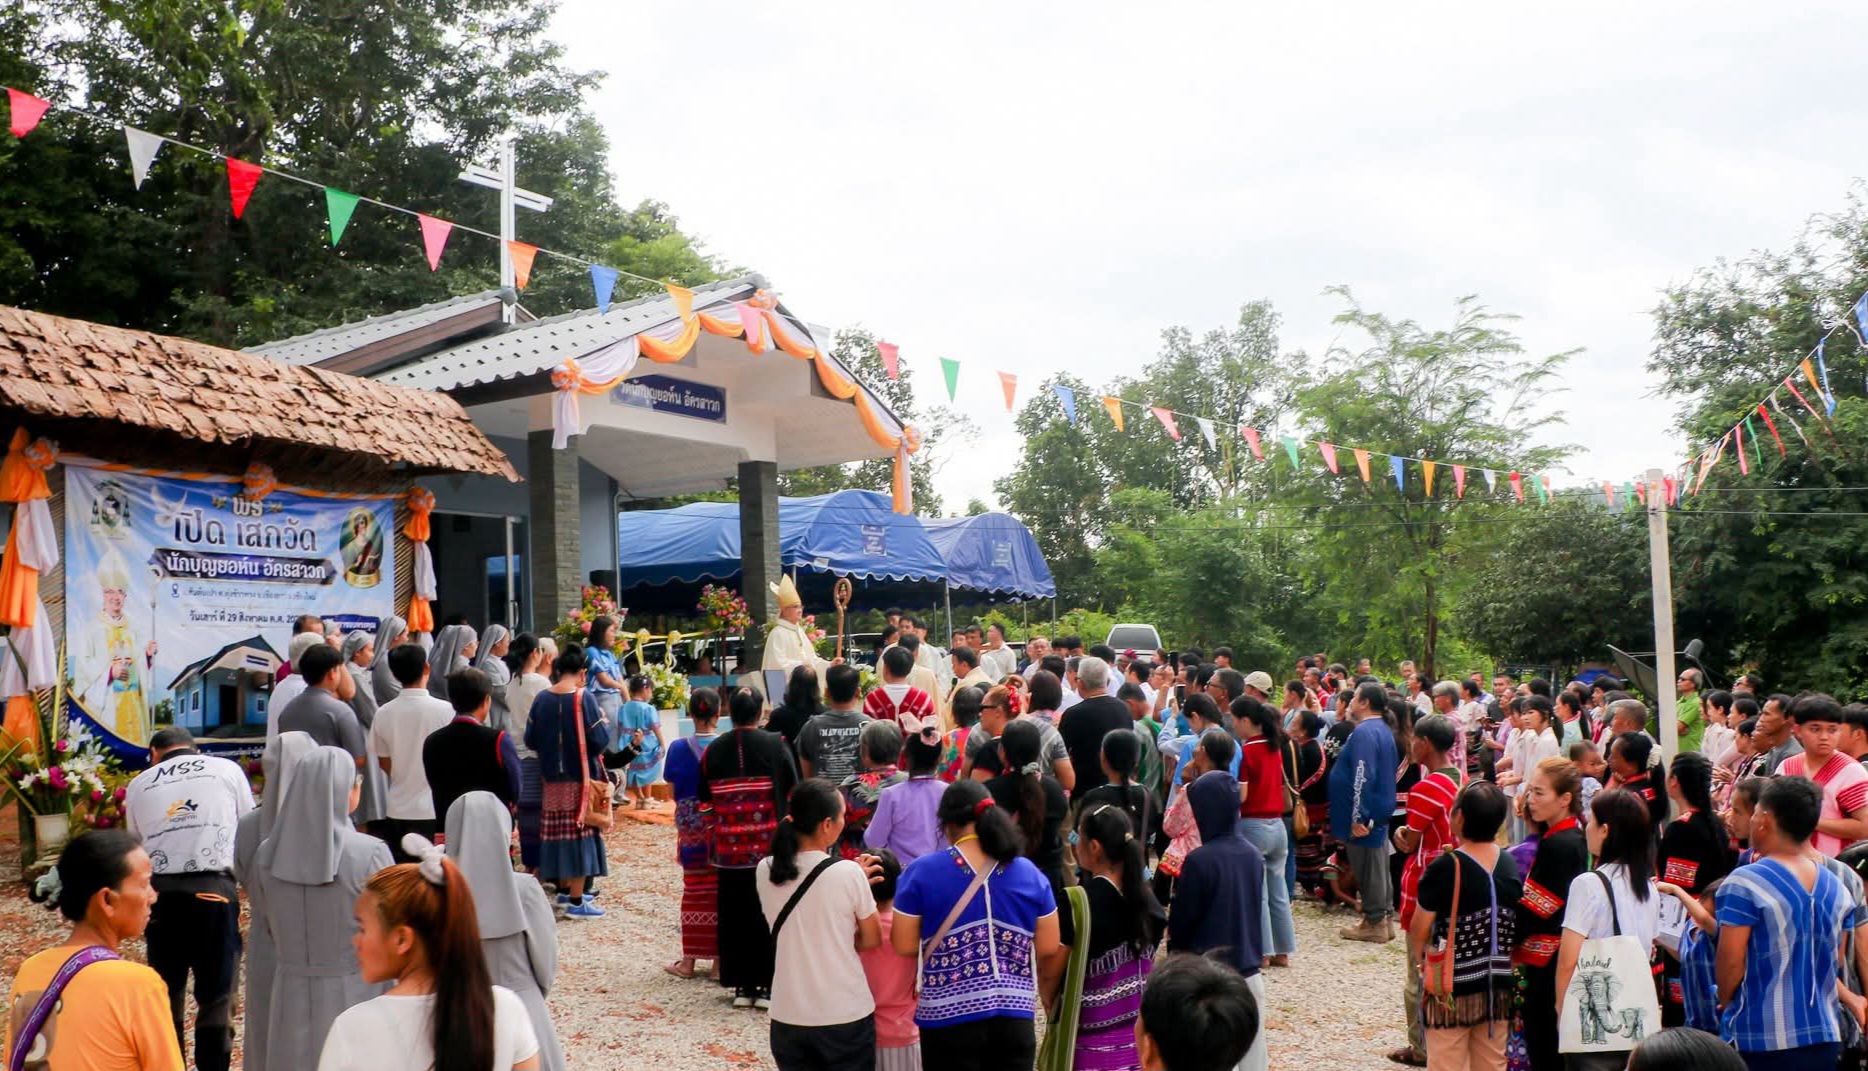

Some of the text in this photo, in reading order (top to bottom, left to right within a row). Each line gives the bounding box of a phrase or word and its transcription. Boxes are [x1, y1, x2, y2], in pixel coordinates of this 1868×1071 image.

[174, 509, 317, 551] เปิด เสกวัด
[166, 551, 326, 579] นักบุญยอห์น อัครสาวก
[227, 613, 237, 621] 29
[152, 760, 205, 783] MSS
